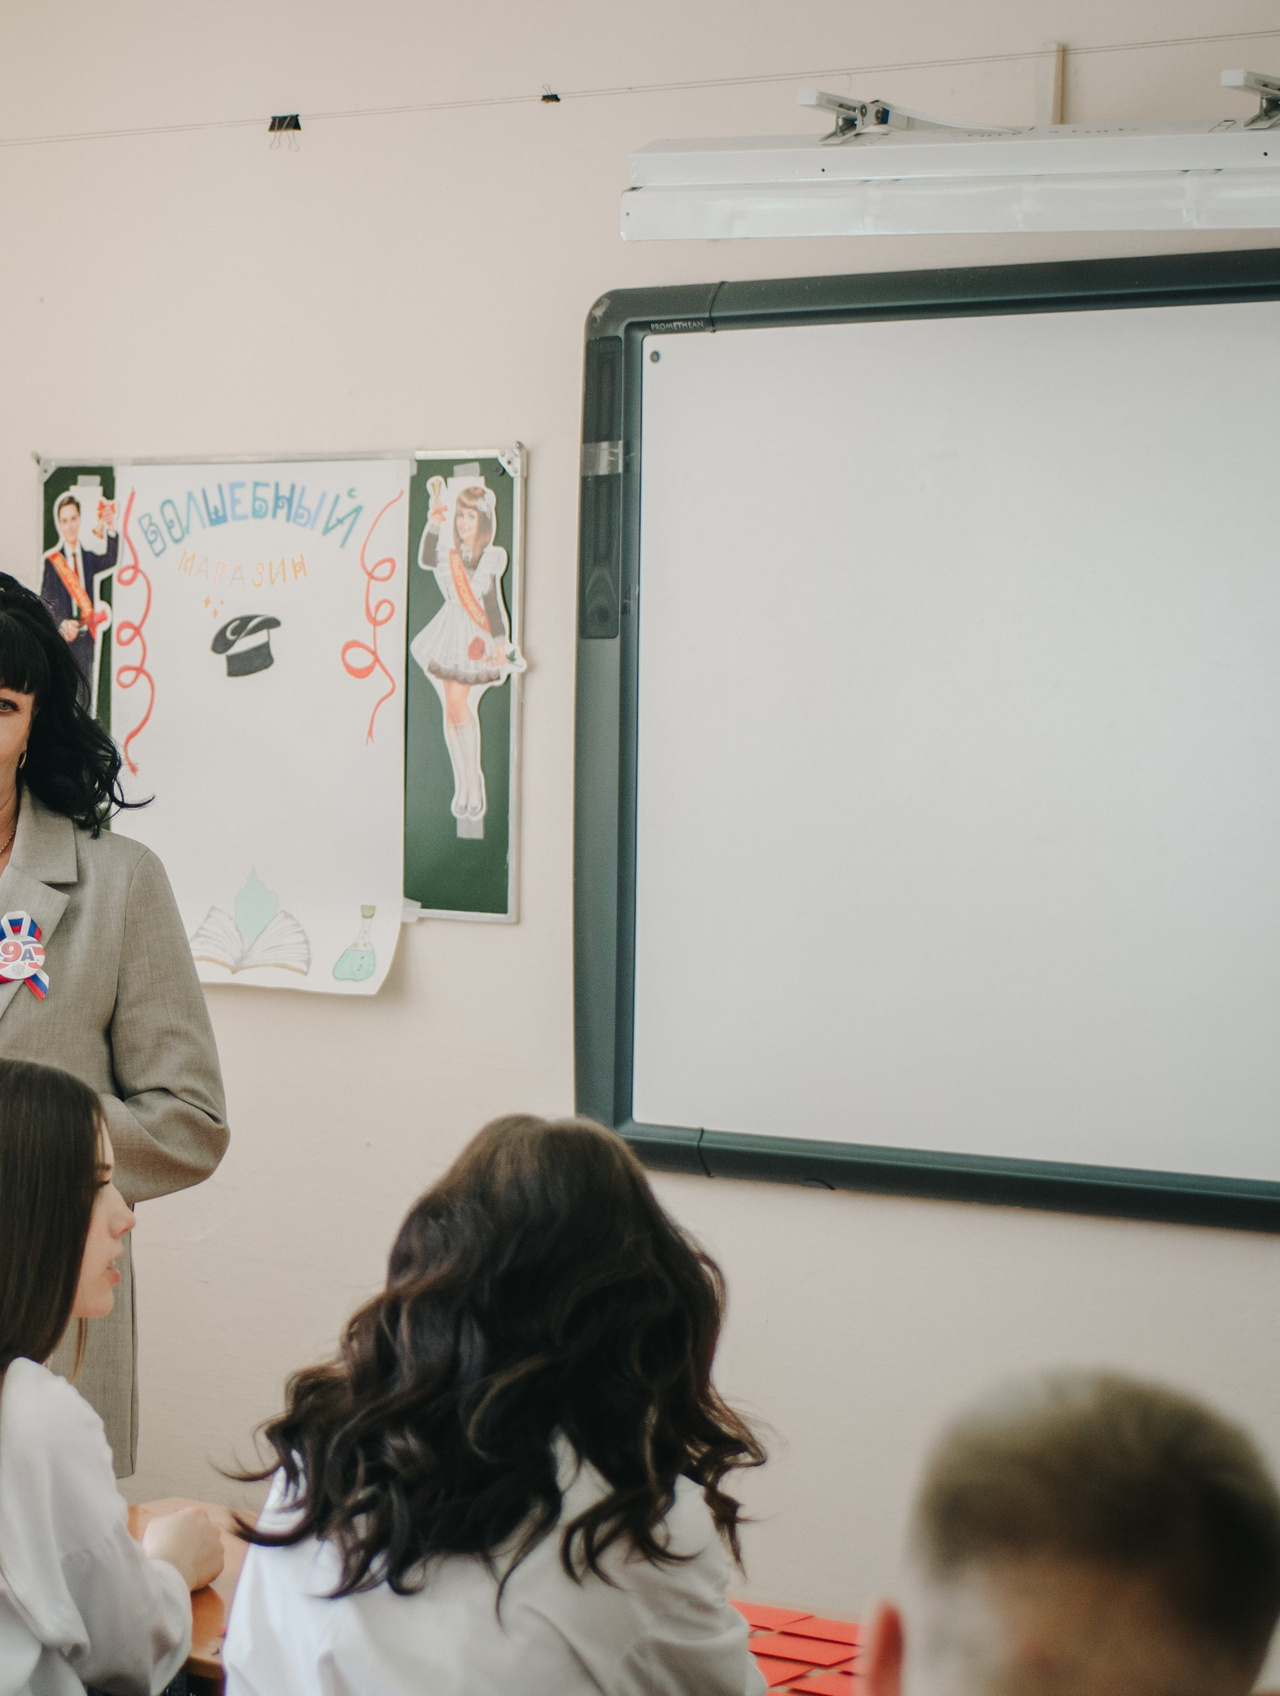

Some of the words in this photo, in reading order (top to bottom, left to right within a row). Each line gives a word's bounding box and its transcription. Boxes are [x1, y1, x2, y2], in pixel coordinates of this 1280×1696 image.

[650, 320, 704, 331] PROMETHEAN
[138, 480, 363, 558] ВОЛШЕБНЫЙ
[177, 550, 308, 588] МАГАЗИН
